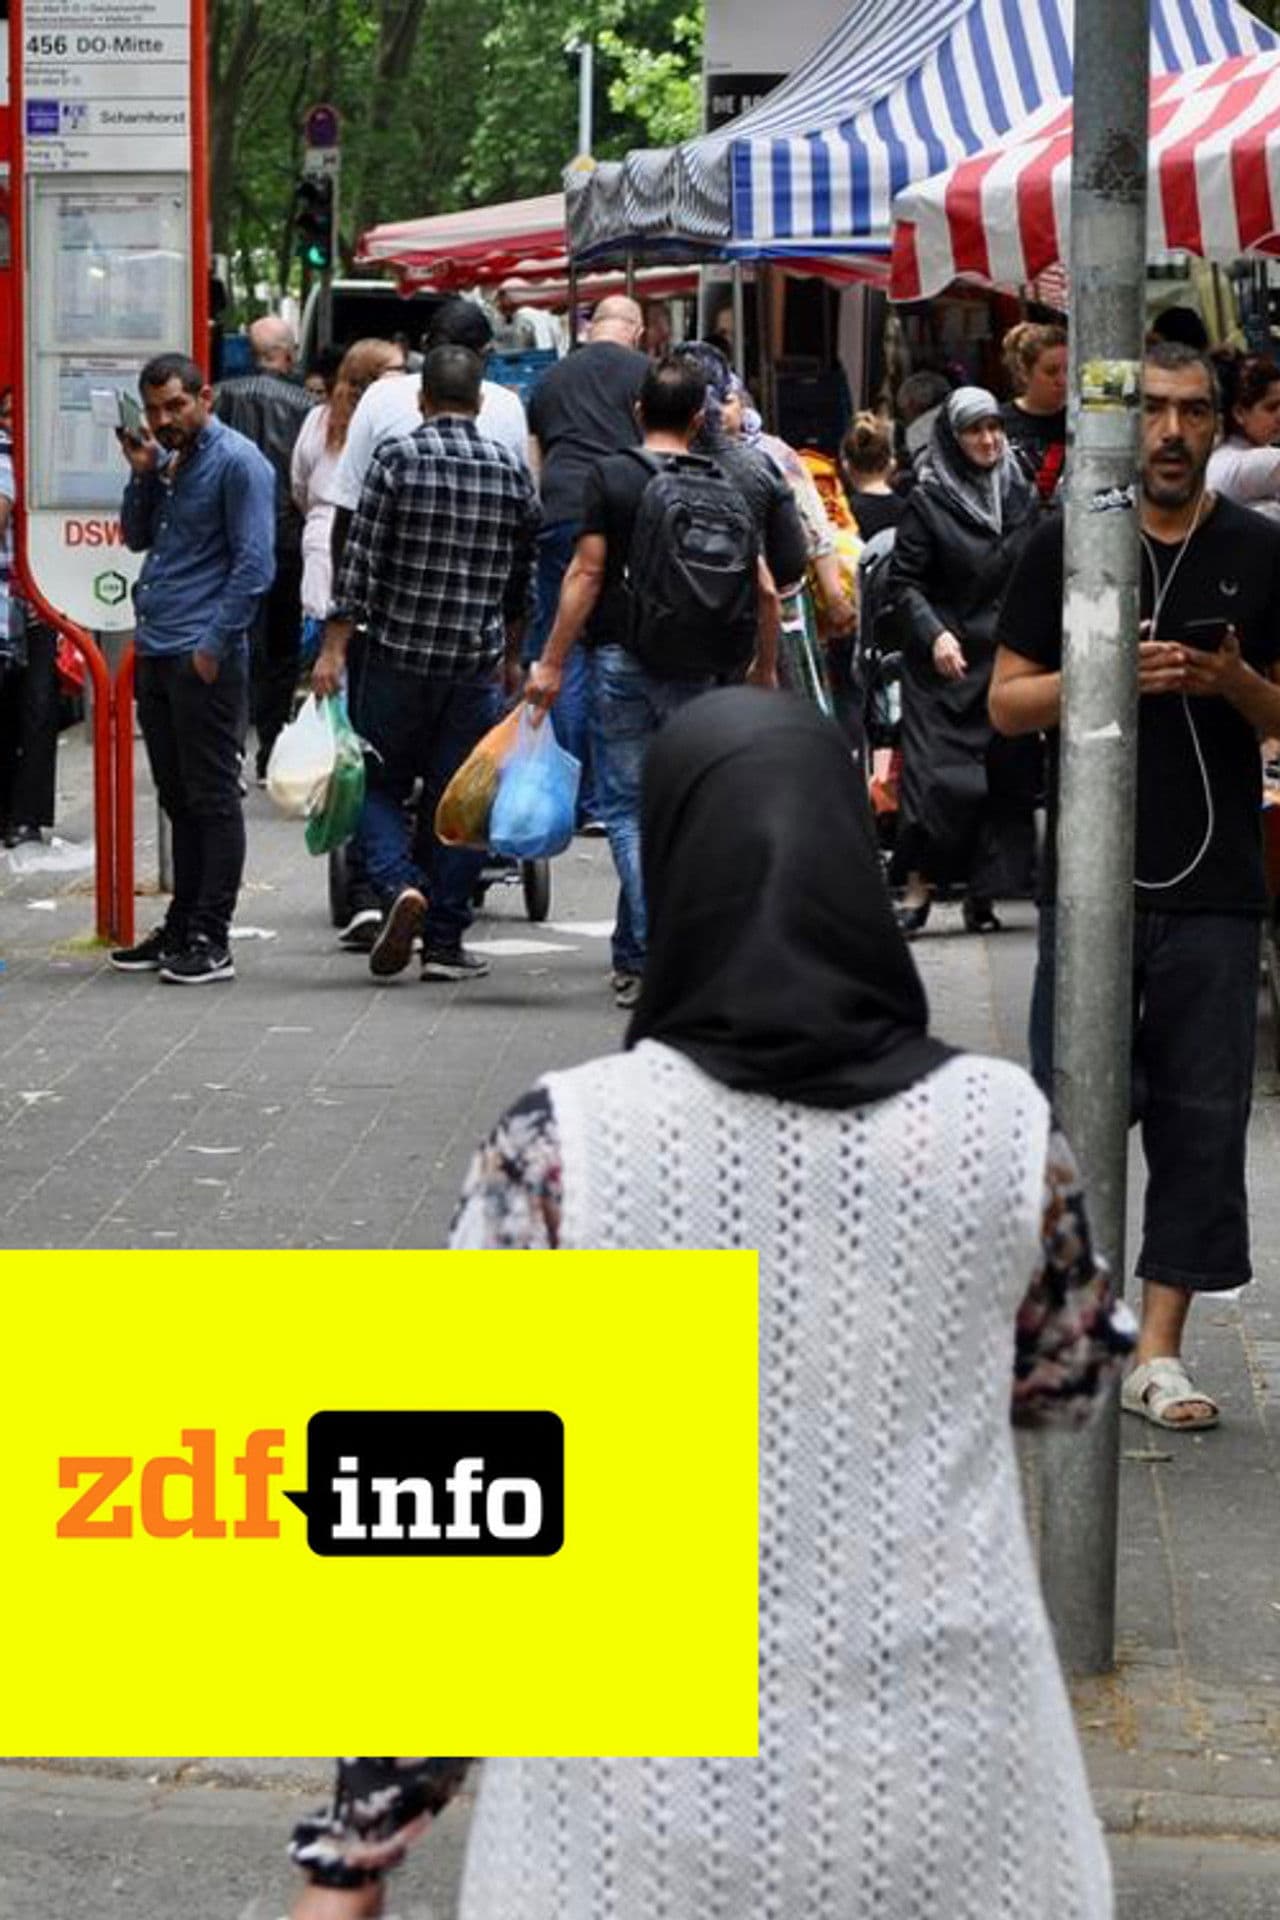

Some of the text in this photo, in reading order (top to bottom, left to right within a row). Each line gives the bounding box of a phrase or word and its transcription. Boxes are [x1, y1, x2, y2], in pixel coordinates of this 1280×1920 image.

[26, 35, 163, 54] 456 DO-Mitte
[100, 109, 185, 124] Scharnhorst
